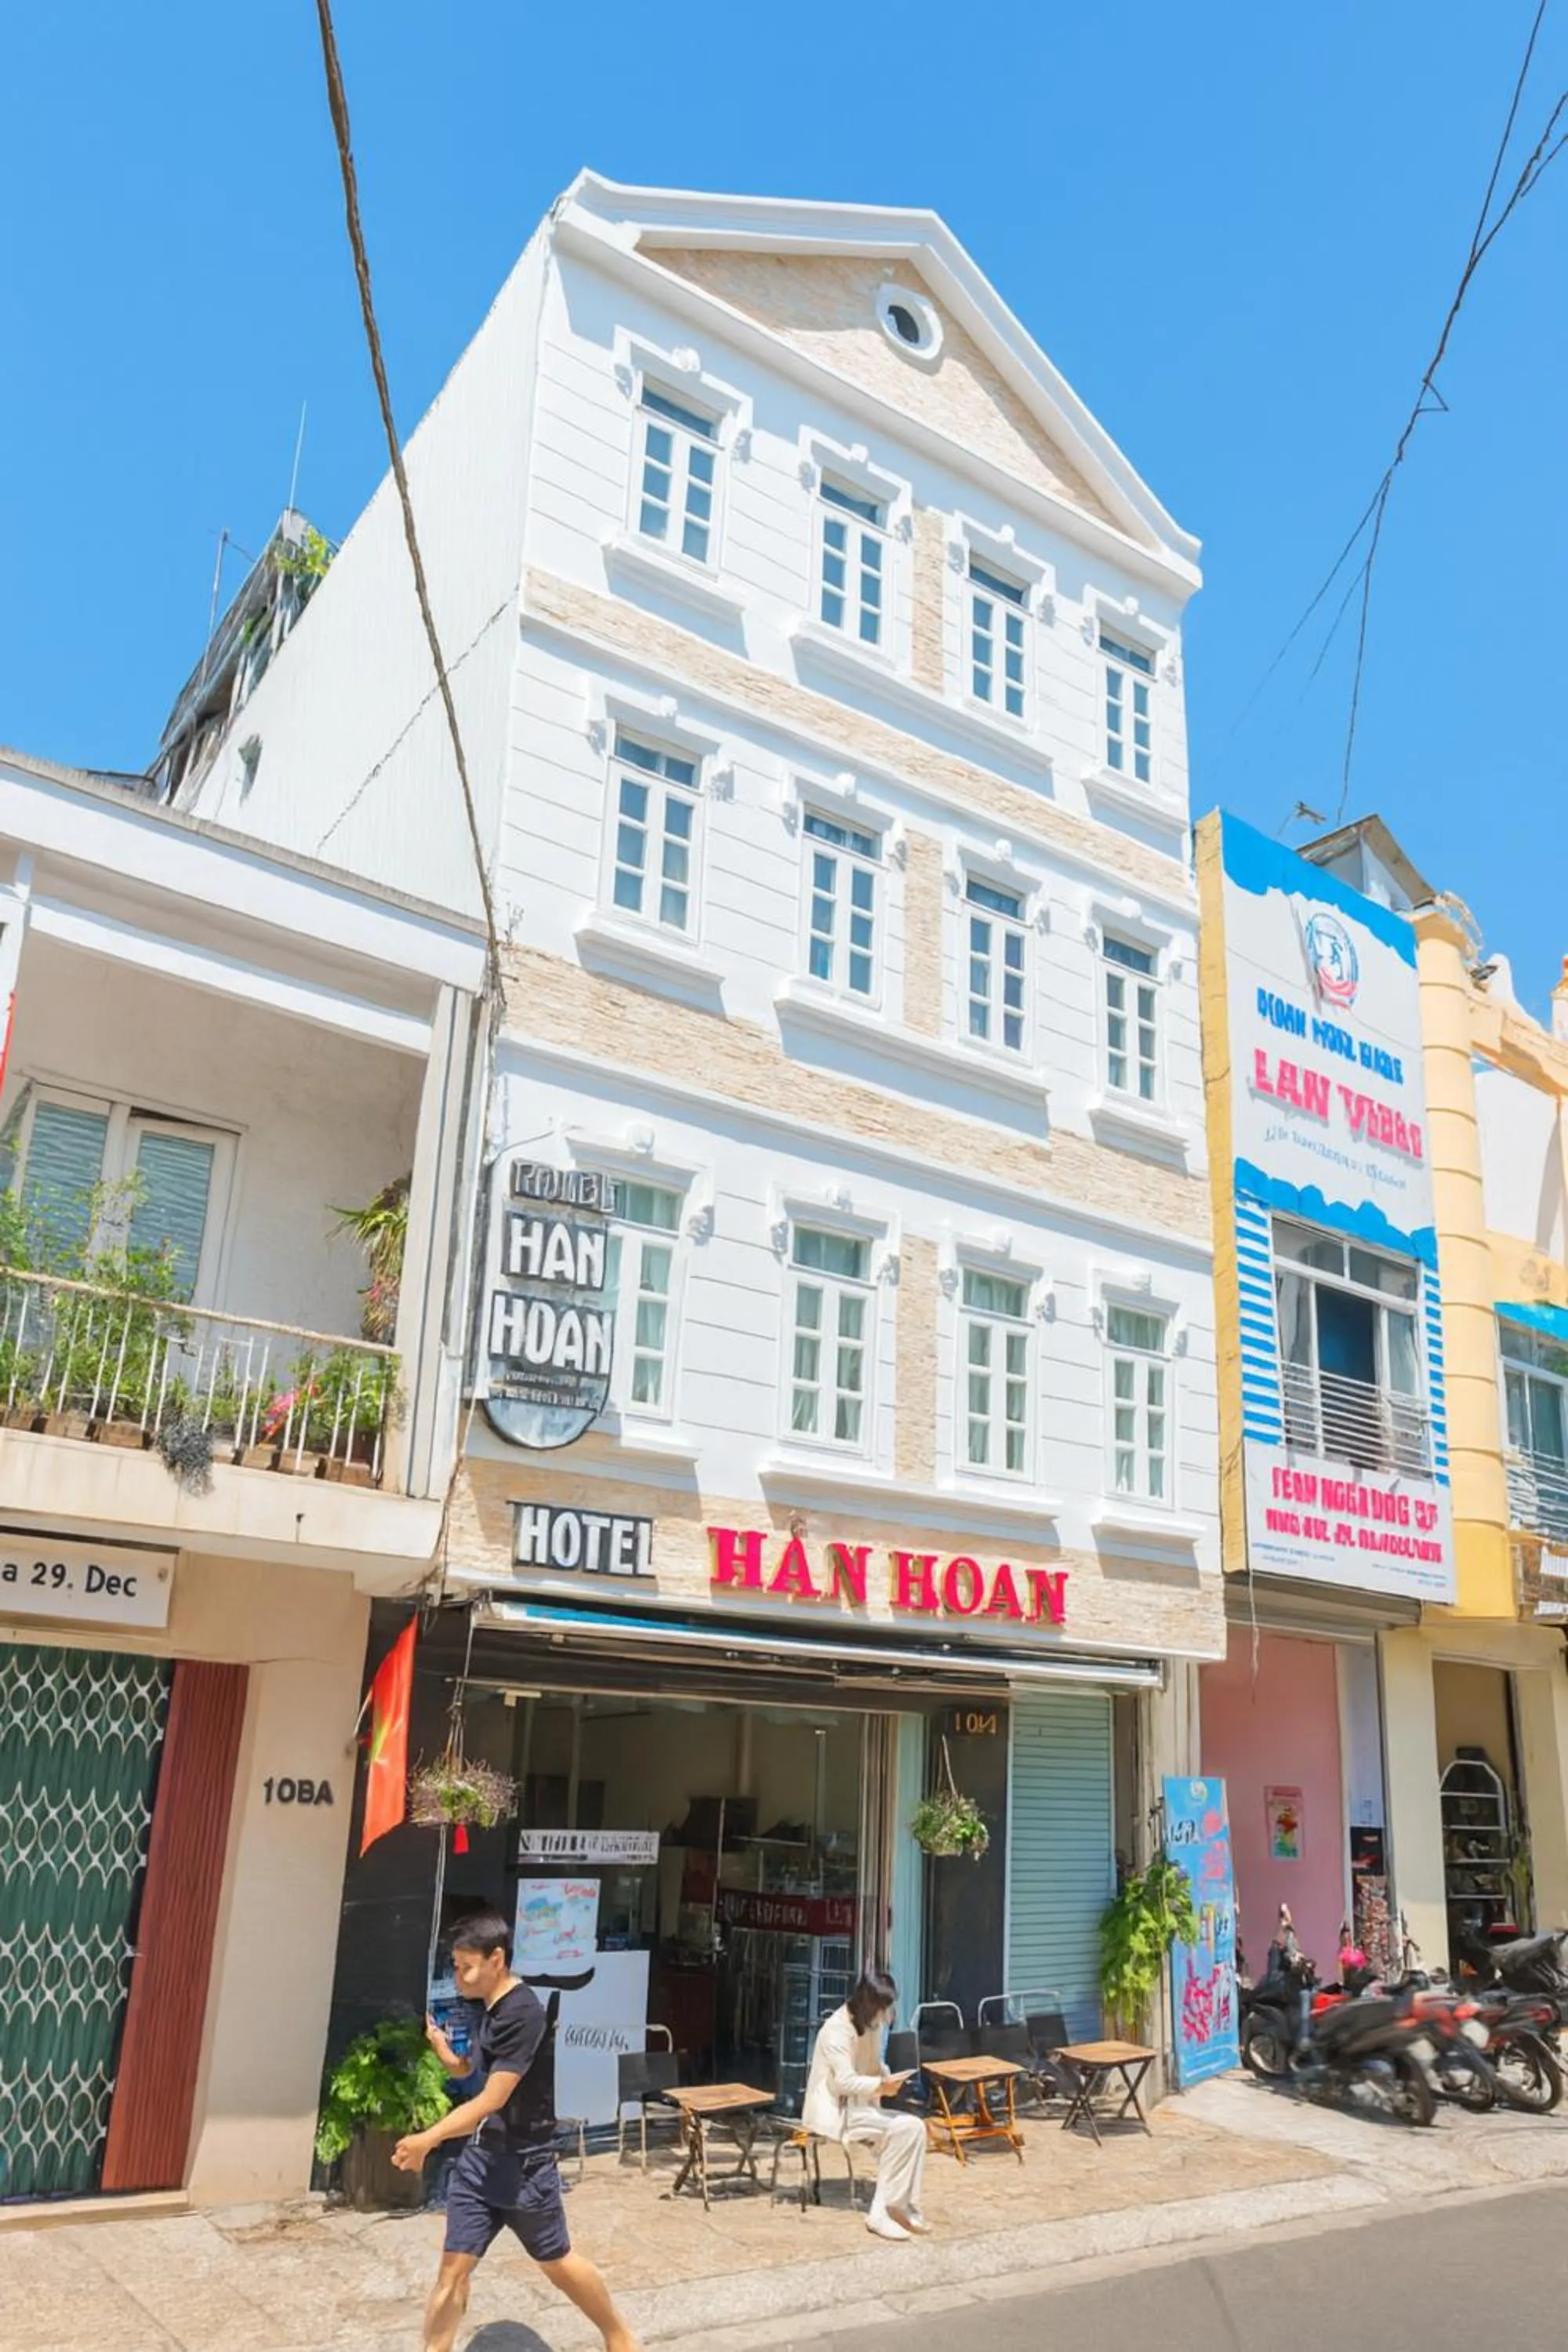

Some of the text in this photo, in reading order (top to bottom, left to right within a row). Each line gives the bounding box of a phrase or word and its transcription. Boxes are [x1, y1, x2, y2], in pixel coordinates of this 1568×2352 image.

[510, 1218, 605, 1288] HAN
[491, 1294, 613, 1374] HOAN
[518, 1505, 655, 1576] HOTEL
[31, 1562, 74, 1589] 29.
[85, 1565, 138, 1597] Dec
[889, 1550, 1069, 1625] HOAN
